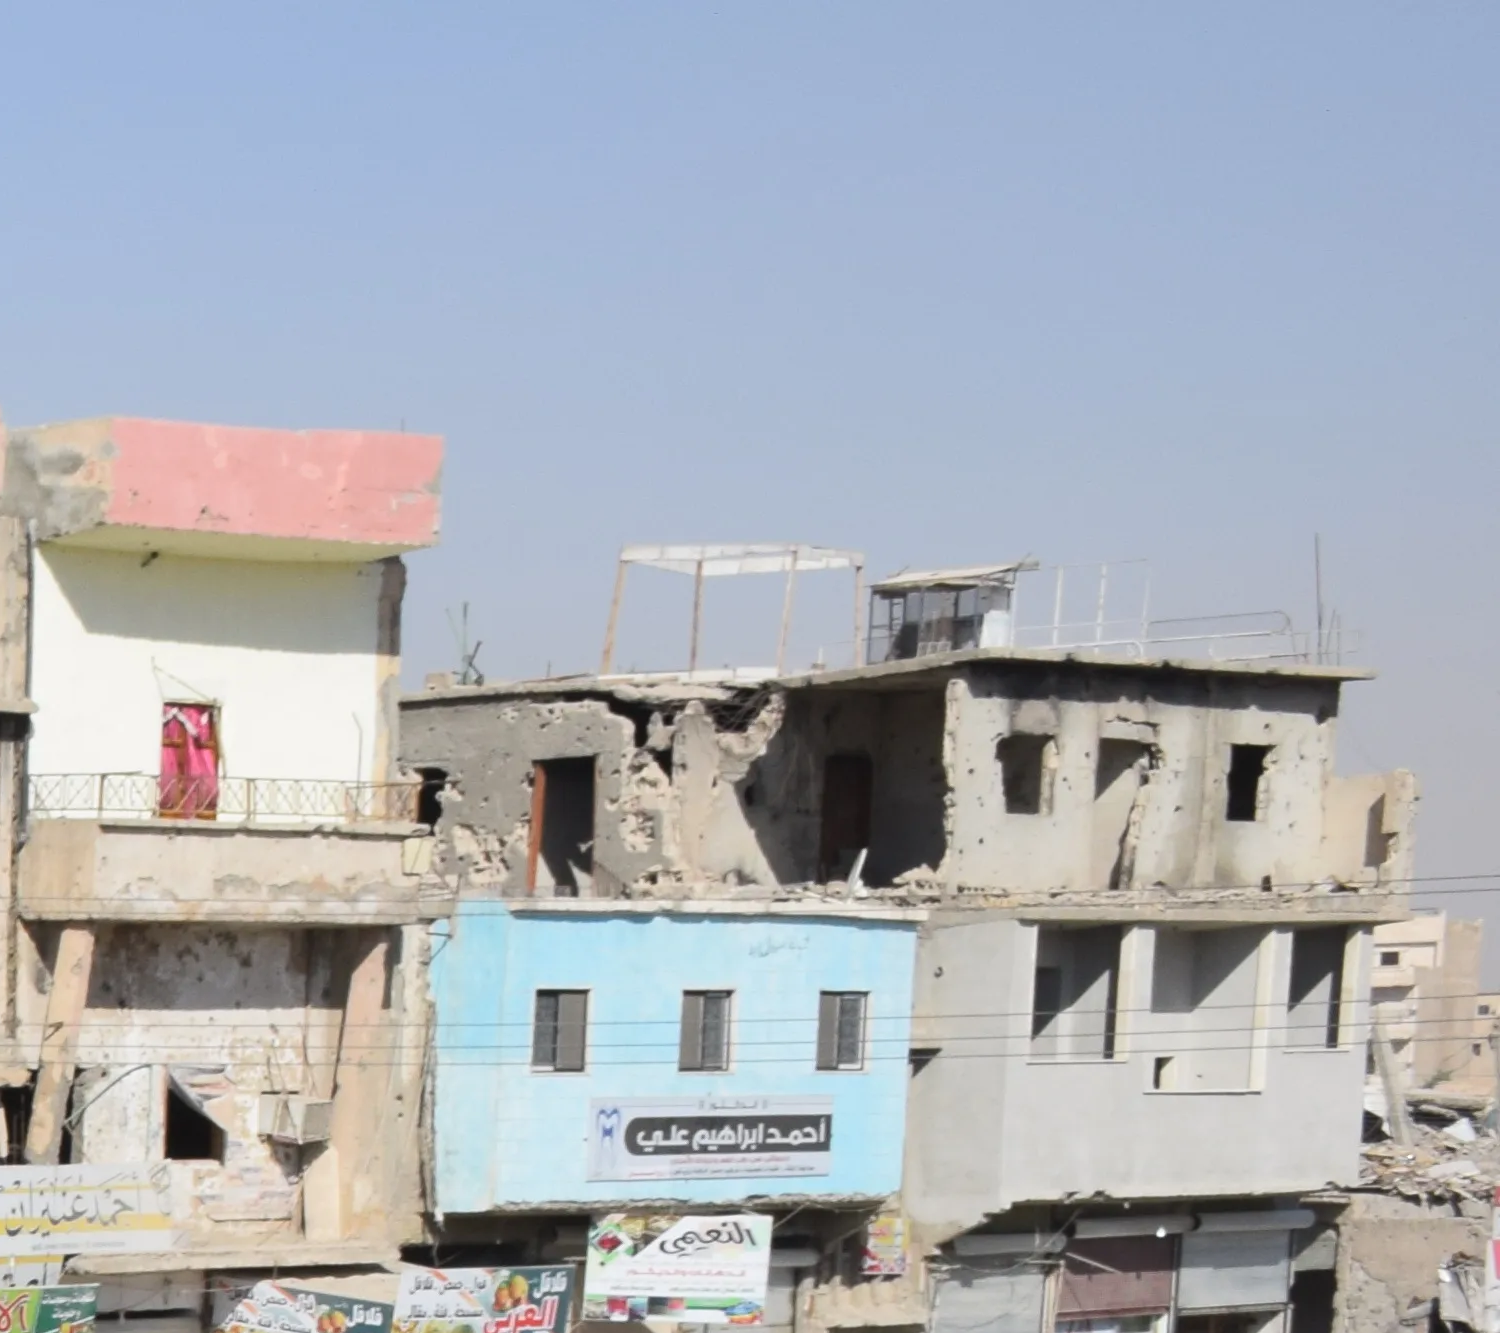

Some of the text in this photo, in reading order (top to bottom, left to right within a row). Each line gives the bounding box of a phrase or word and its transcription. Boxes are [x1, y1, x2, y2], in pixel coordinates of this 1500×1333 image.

[635, 1124, 691, 1153] علي
[765, 1116, 827, 1147] أحمد
[659, 1220, 758, 1258] النعيمي
[532, 1272, 567, 1298] فلافل
[346, 1303, 384, 1327] فلافل
